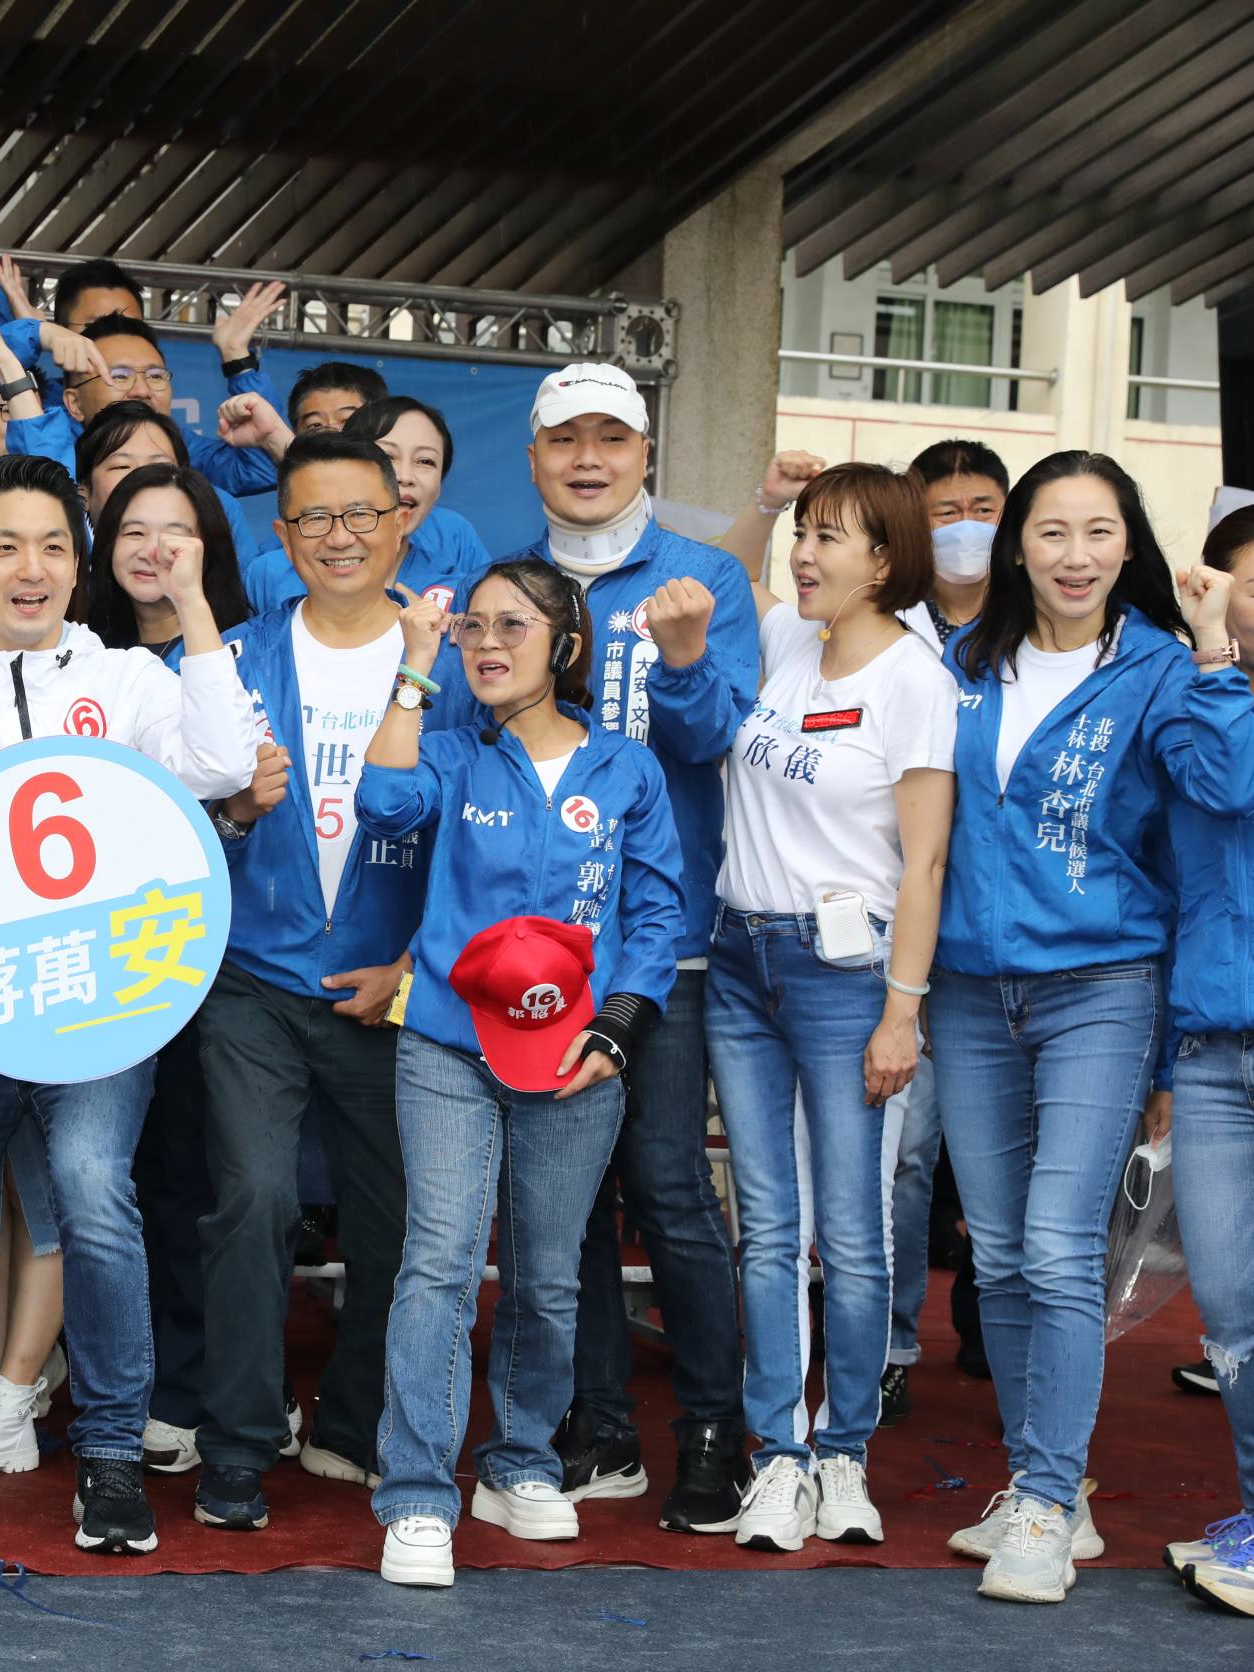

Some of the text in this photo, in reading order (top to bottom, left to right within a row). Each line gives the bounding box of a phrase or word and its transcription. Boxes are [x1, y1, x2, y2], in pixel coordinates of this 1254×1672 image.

[311, 742, 355, 786] 世
[729, 734, 823, 785] 欣儀
[315, 798, 344, 839] 5
[462, 803, 514, 827] KMT
[565, 798, 595, 829] 16
[9, 771, 96, 899] 6
[527, 990, 556, 1008] 16
